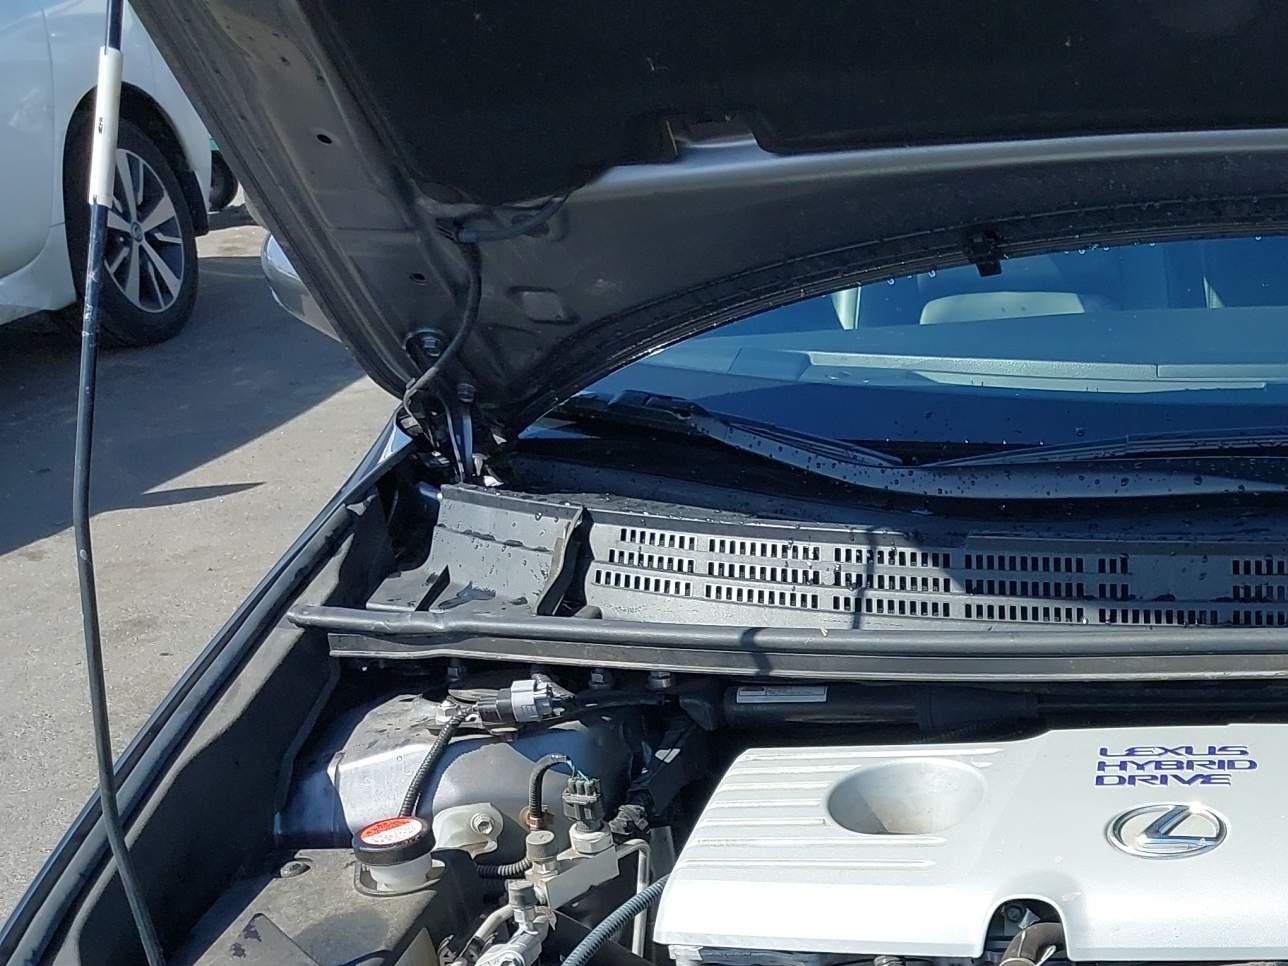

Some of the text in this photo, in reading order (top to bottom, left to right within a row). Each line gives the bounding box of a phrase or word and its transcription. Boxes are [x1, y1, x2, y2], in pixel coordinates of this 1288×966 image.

[1099, 745, 1249, 757] LEXUS
[1096, 759, 1258, 771] HYBRID
[1094, 773, 1232, 786] DRIVE
